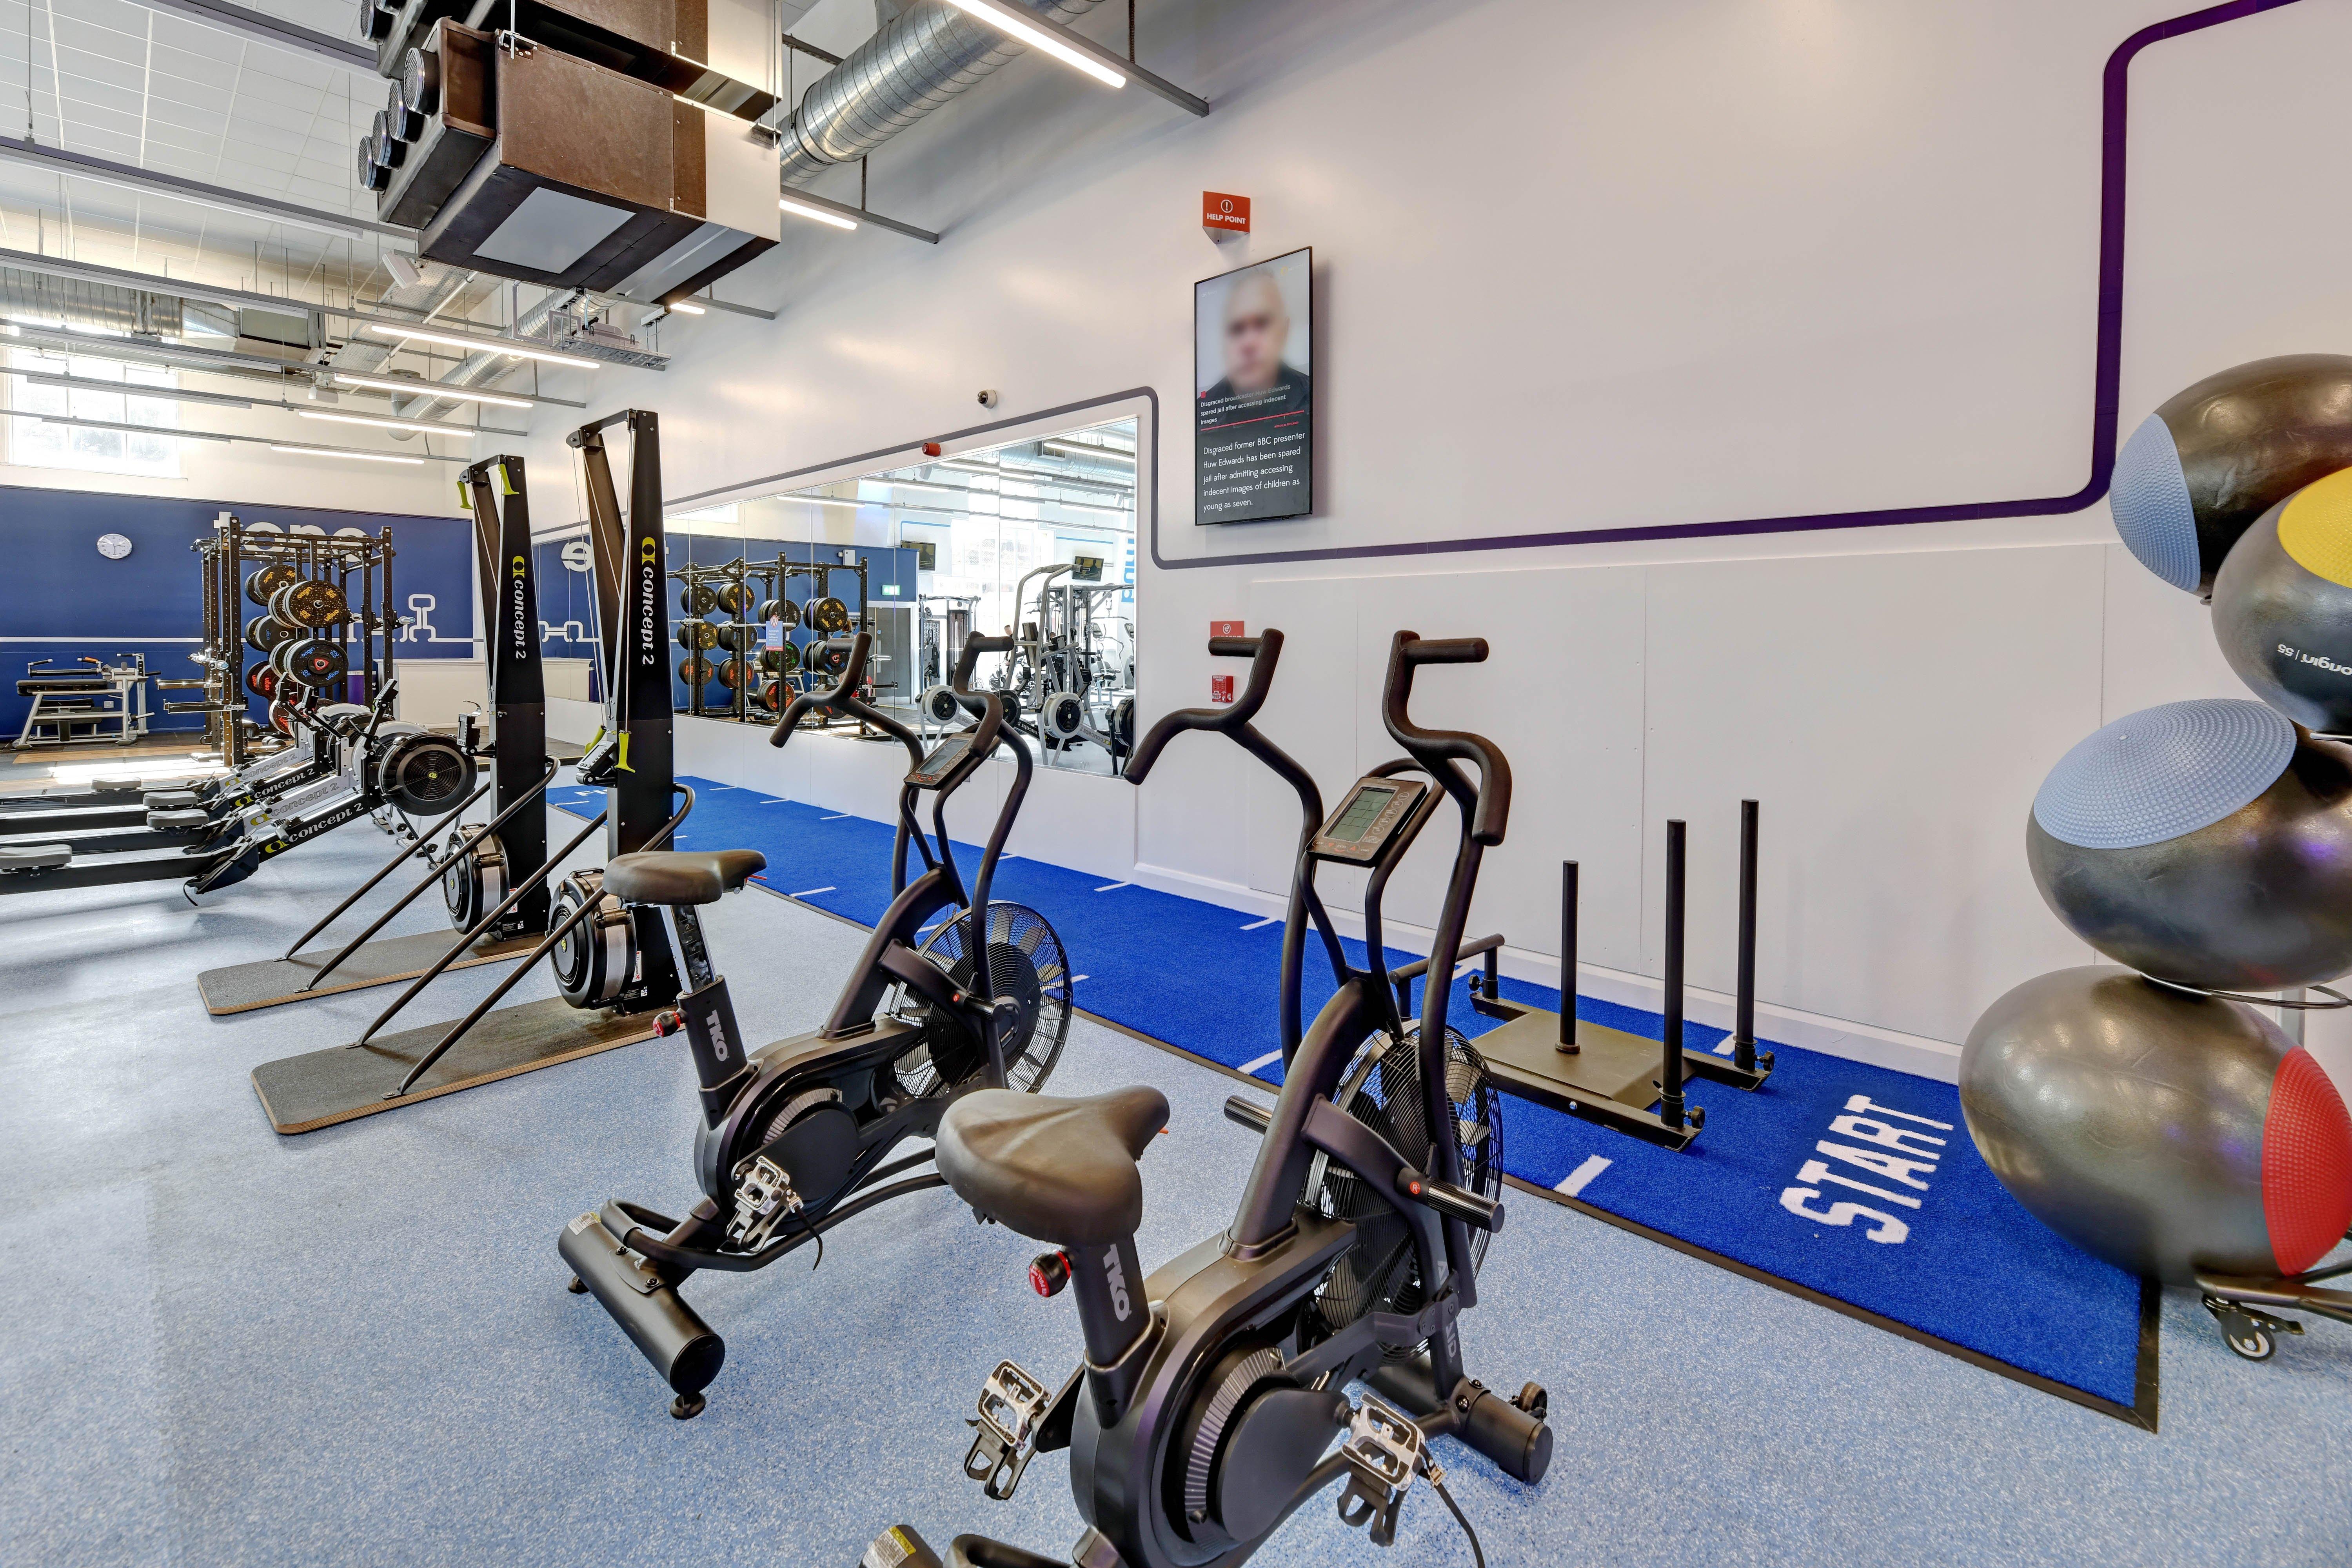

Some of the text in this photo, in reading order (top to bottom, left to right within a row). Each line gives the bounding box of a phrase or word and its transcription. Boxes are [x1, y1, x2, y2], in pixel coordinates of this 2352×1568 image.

[1225, 215, 1246, 224] POINT
[1201, 397, 1224, 407] Disgraced
[1225, 392, 1254, 403] broadcaster
[1268, 384, 1291, 394] Edwards
[1238, 400, 1262, 408] accessing
[1263, 394, 1286, 403] indecent
[1204, 432, 1305, 456] Disgraced former BBC presenter
[1219, 456, 1244, 466] Edwards
[1278, 446, 1301, 459] spared
[1203, 475, 1212, 485] jail
[1229, 469, 1258, 478] admitting
[1260, 465, 1293, 474] accessing
[1203, 486, 1229, 496] indecent
[1231, 484, 1253, 494] images
[1255, 481, 1262, 490] of
[1264, 479, 1290, 489] children
[1203, 503, 1222, 513] young
[263, 571, 274, 583] origin
[297, 586, 313, 599] origin
[324, 610, 339, 621] origin
[514, 580, 526, 659] concept 2
[642, 567, 654, 665] concept 2
[301, 647, 315, 657] origin
[2277, 644, 2294, 657] 55
[2301, 653, 2352, 675] origin
[325, 670, 339, 680] origin
[242, 756, 289, 780] concept
[254, 774, 306, 799] concept
[271, 782, 340, 817] concept 2
[289, 803, 364, 842] concept 2
[706, 1009, 728, 1062] TKO
[1779, 1094, 1954, 1244] START
[1103, 1243, 1130, 1321] TKO
